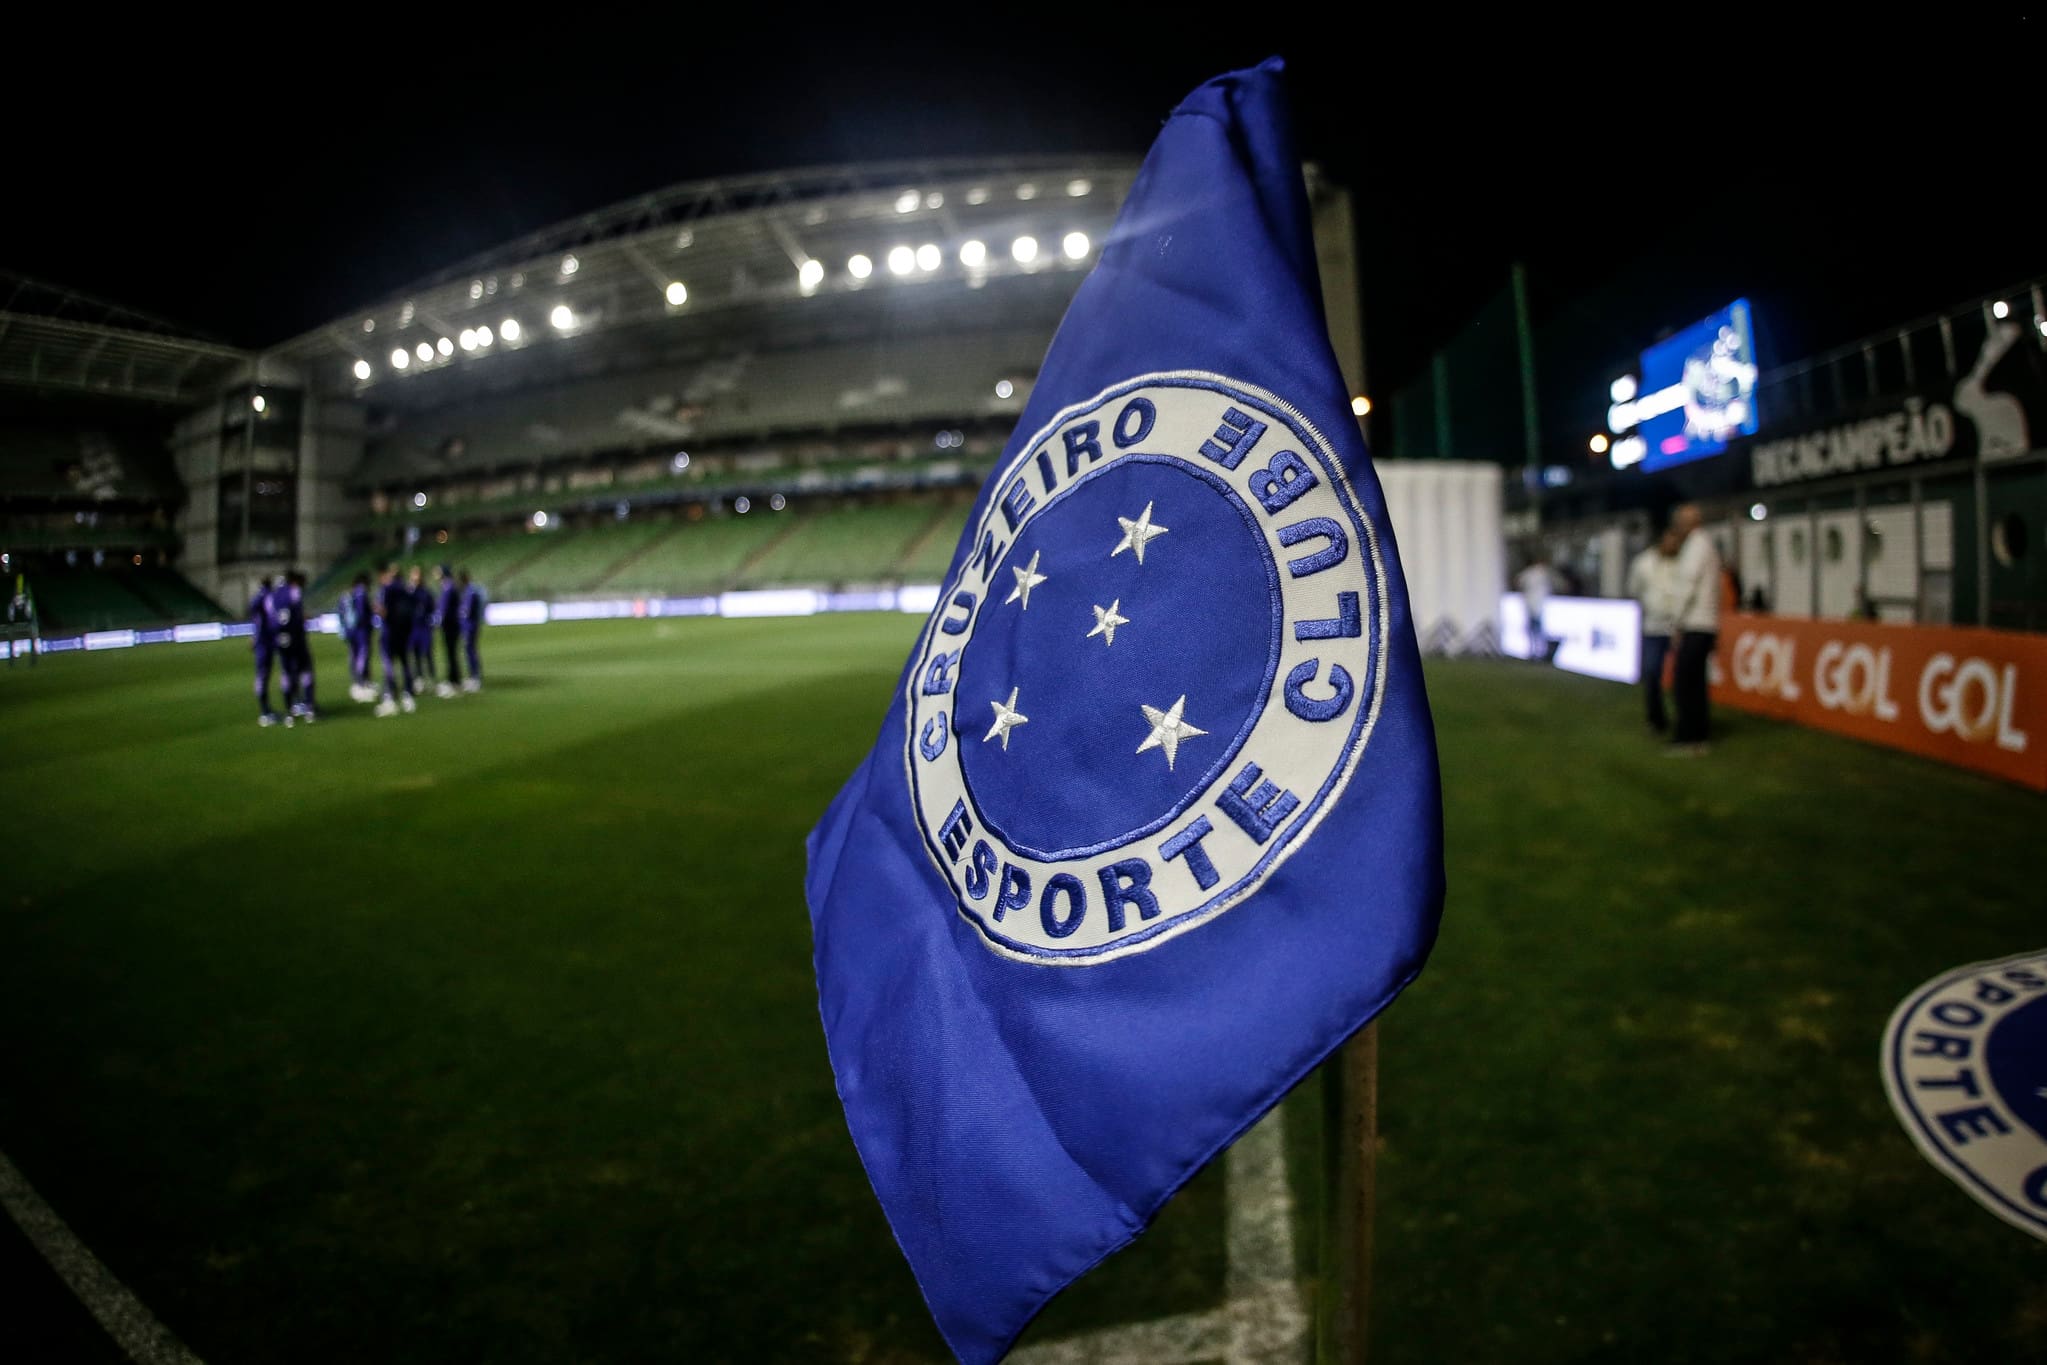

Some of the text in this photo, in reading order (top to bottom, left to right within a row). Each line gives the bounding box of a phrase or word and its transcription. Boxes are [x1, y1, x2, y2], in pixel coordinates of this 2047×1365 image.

[919, 396, 1362, 939] CRUZEIRO ESPORTE CLUBE
[1732, 631, 1800, 701] GOL
[1813, 639, 1899, 722] GOL
[1919, 651, 2029, 753] GOL
[1910, 970, 2047, 1146] SPORTE
